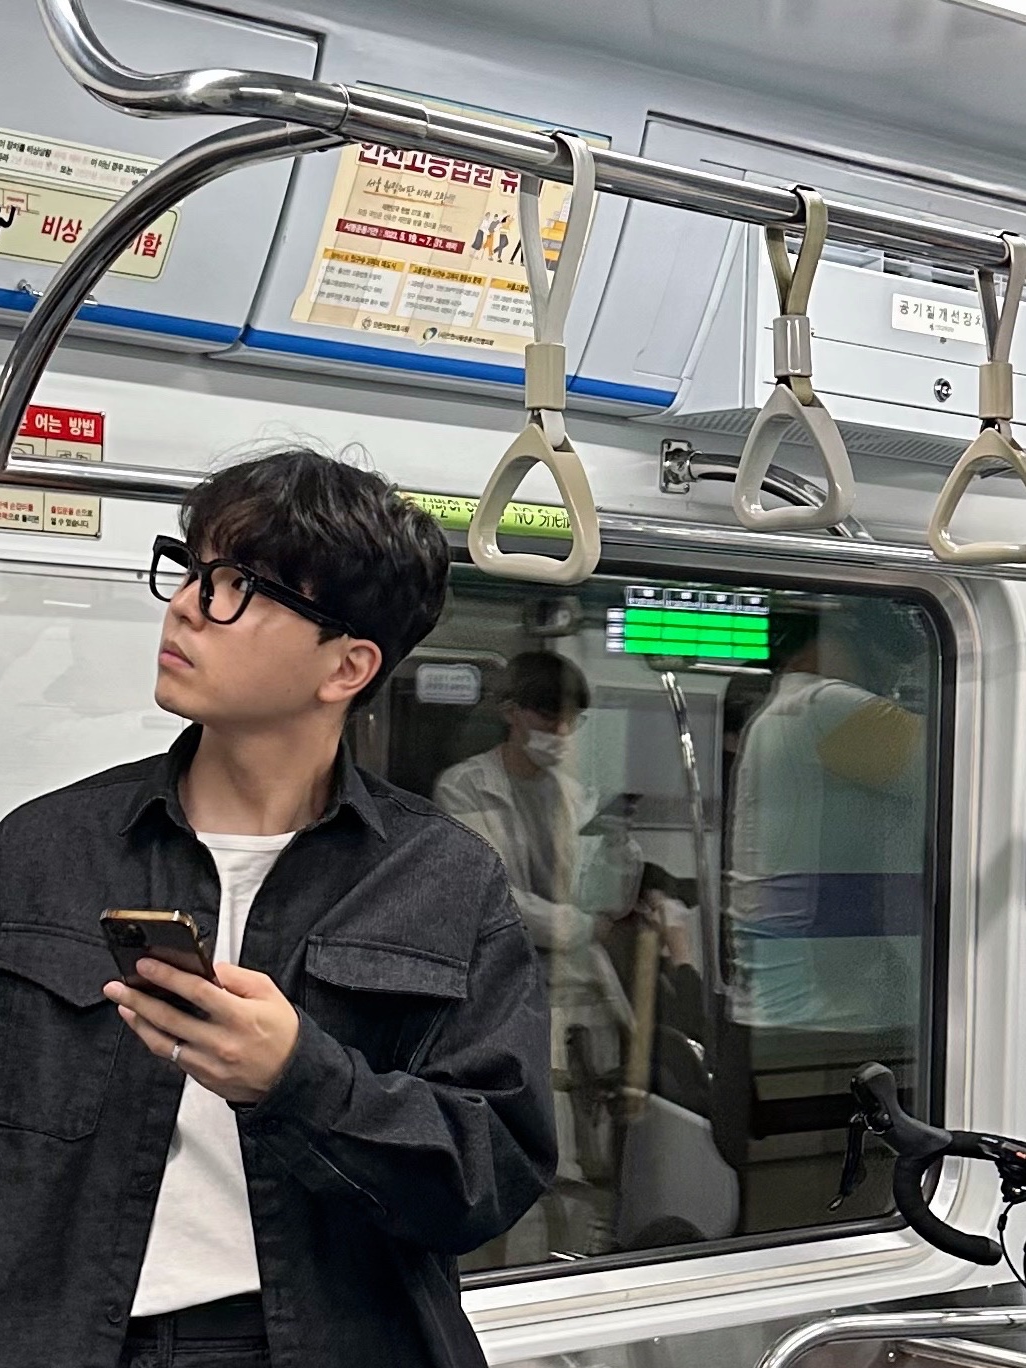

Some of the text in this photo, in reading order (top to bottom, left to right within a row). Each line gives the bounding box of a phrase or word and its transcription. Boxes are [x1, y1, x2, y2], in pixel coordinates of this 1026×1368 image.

[41, 215, 83, 244] 비상
[34, 413, 62, 434] 여는
[68, 417, 95, 438] 방법
